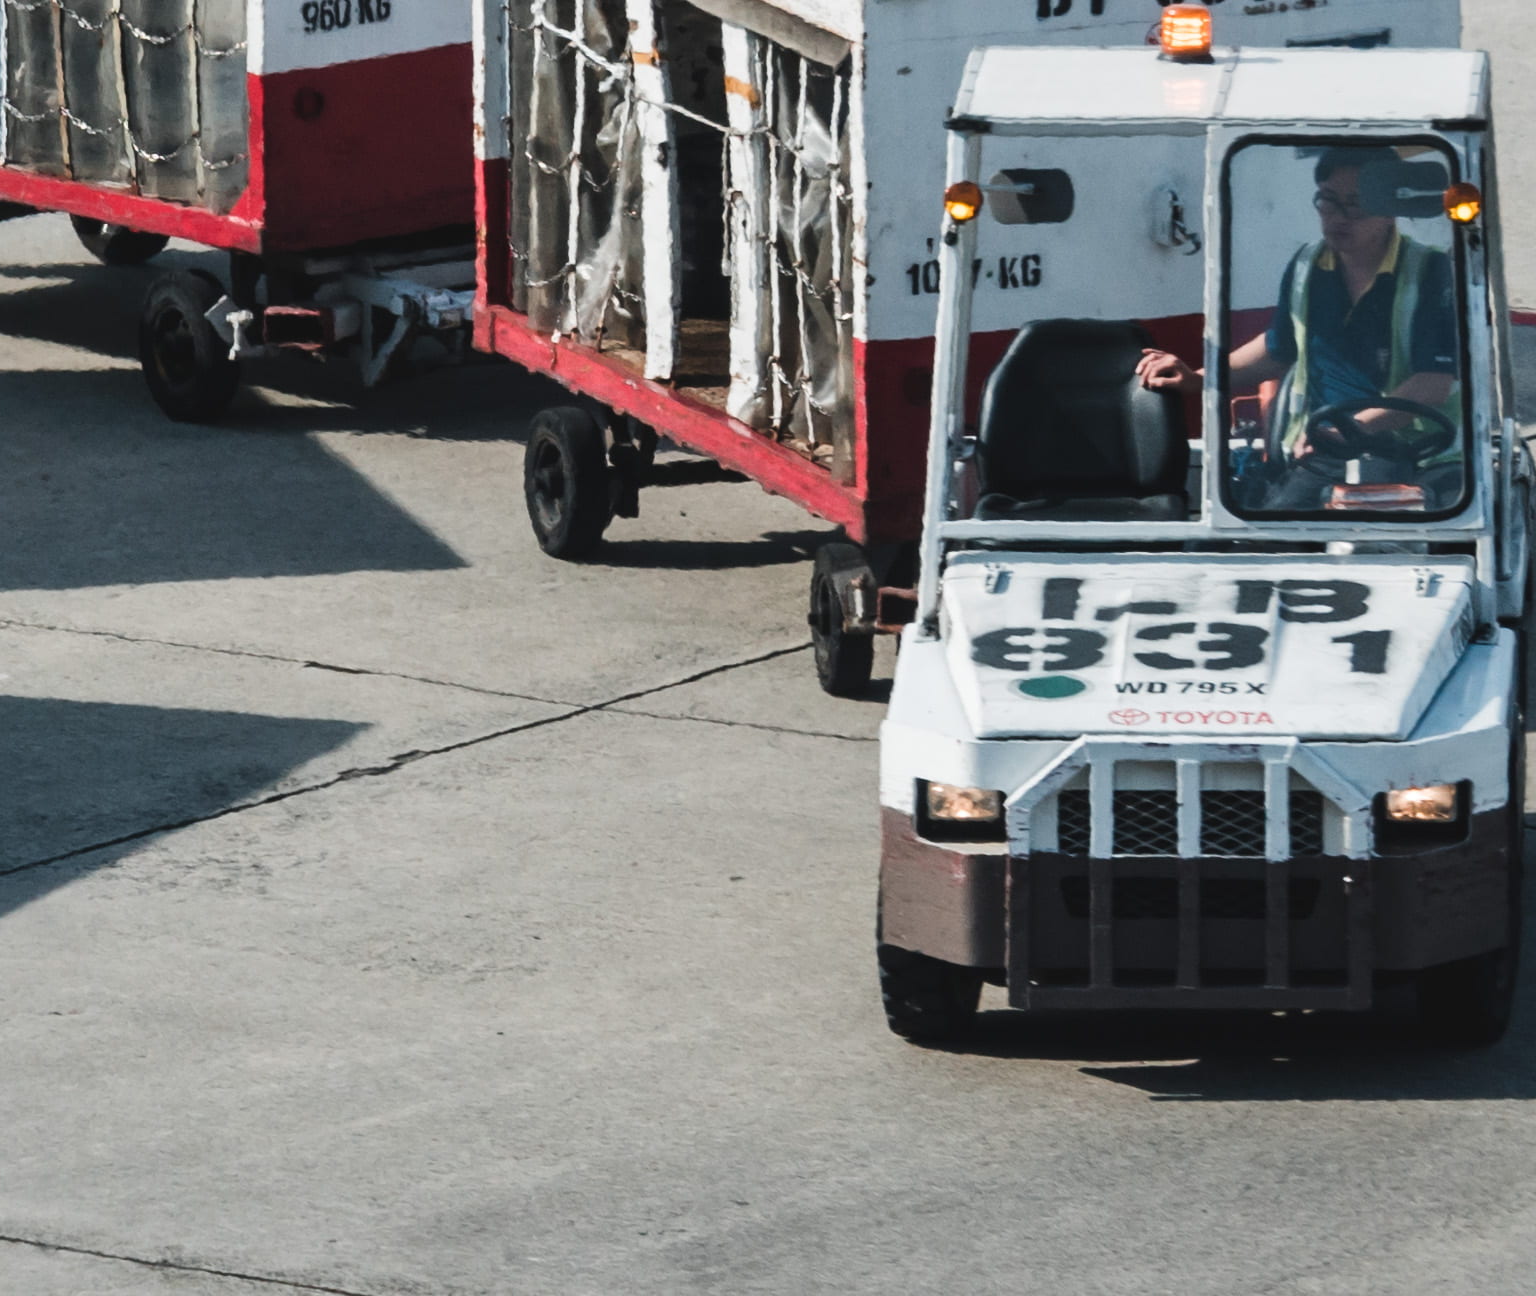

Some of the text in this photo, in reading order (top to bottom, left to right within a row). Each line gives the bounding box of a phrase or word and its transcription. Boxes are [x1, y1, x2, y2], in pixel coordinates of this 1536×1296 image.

[300, 0, 351, 35] 960
[971, 621, 1394, 675] 831
[1155, 710, 1275, 725] TOYOTA
